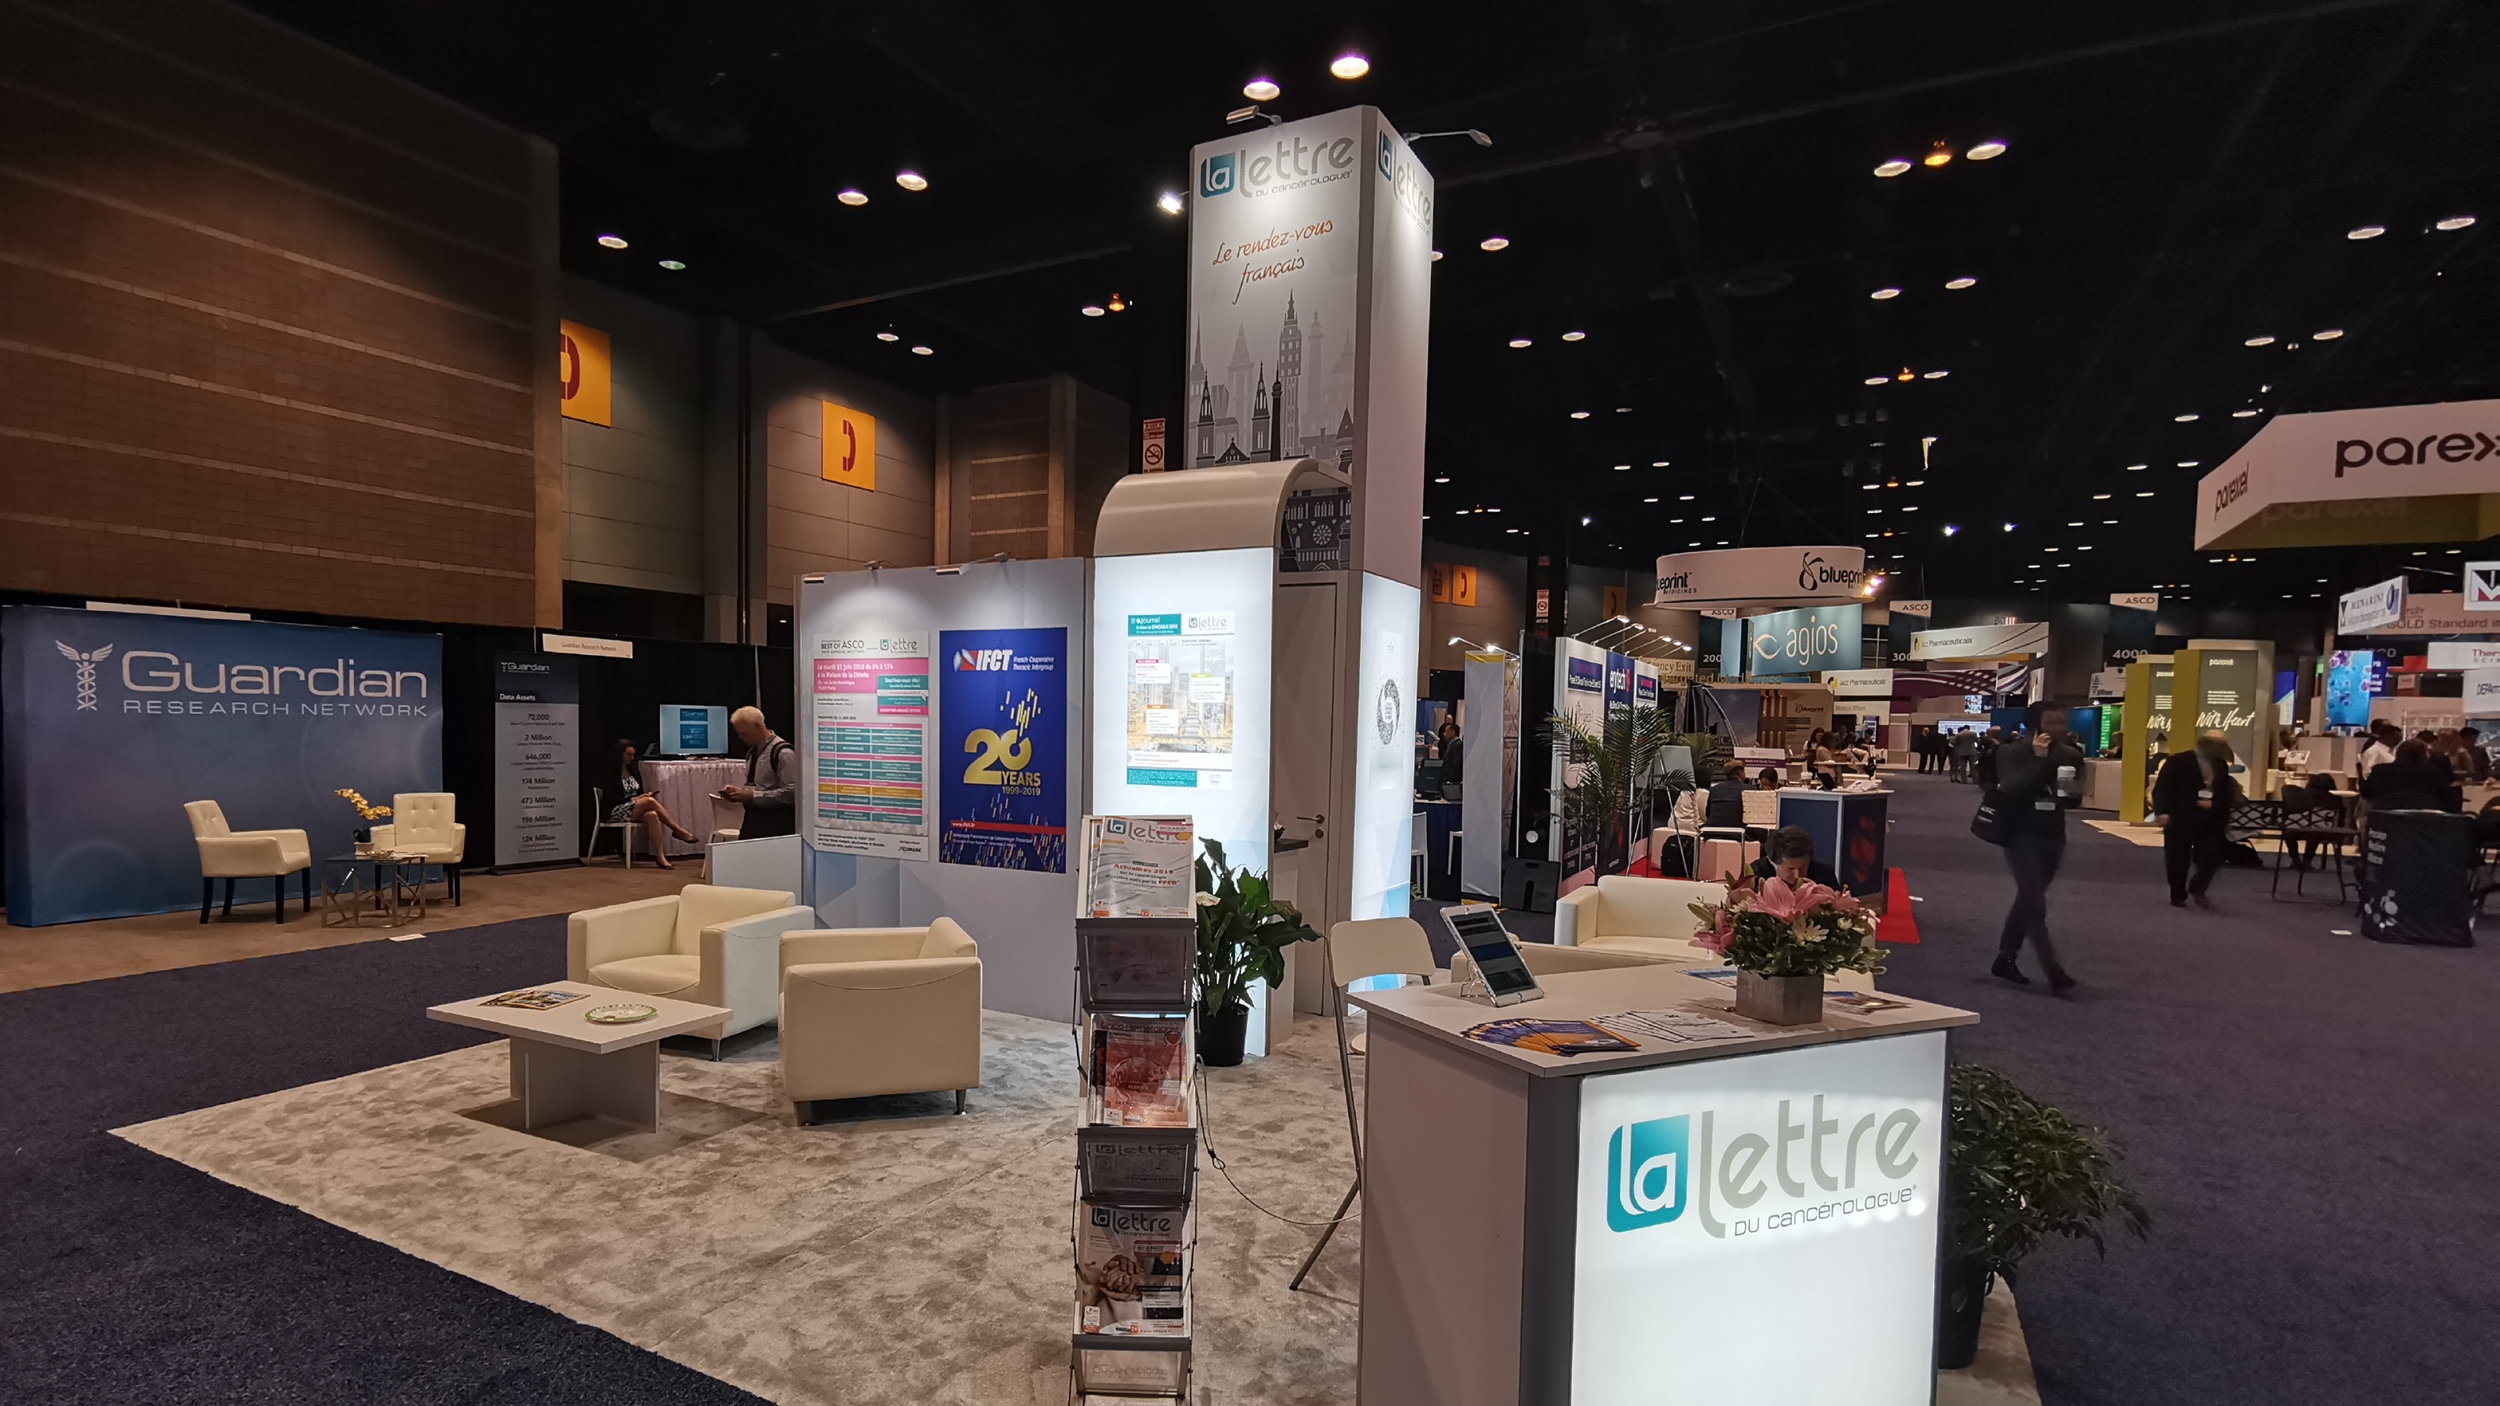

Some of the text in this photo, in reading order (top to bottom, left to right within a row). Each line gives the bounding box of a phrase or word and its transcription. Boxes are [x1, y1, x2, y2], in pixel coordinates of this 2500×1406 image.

[1204, 137, 1354, 198] la lettre
[1212, 220, 1334, 266] Le rendez-vous
[1231, 249, 1306, 306] français
[2214, 462, 2250, 522] parexel
[2428, 619, 2488, 628] Standard
[841, 640, 864, 648] ASCO
[1786, 615, 1838, 666] agios
[1929, 637, 1972, 646] Pharmaceuticals
[975, 649, 1014, 672] IFCT
[1676, 661, 1692, 672] Exit
[122, 651, 426, 698] Guardian
[1661, 673, 1714, 686] Targeted
[123, 700, 428, 716] RESEARCH NETWORK
[2196, 708, 2256, 732] With Heart
[1001, 771, 1040, 786] YEARS
[1001, 786, 1040, 796] 1999-2019
[1114, 864, 1152, 872] Actualités
[1614, 1093, 1922, 1238] la lettre
[1112, 1210, 1170, 1234] lettre
[1734, 1217, 1760, 1236] DU
